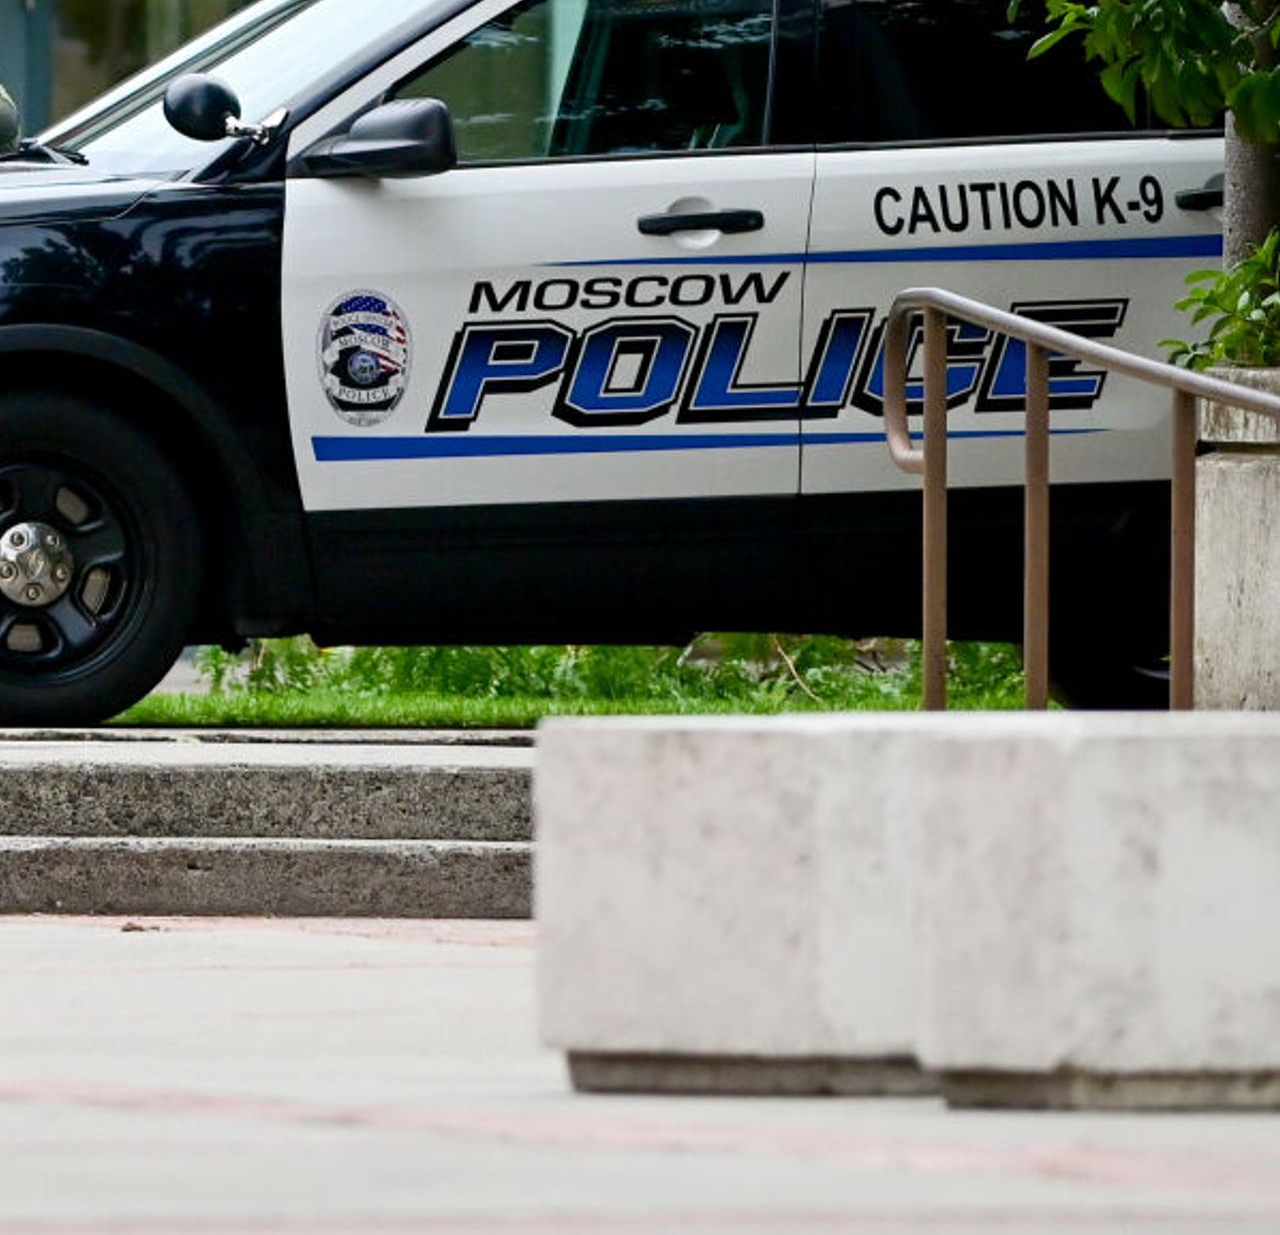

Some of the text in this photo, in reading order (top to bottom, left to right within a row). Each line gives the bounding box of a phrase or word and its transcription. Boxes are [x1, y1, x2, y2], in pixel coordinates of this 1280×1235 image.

[873, 174, 1165, 236] CAUTION K-9
[468, 270, 791, 314] MOSCOW
[425, 297, 1130, 434] POLICE
